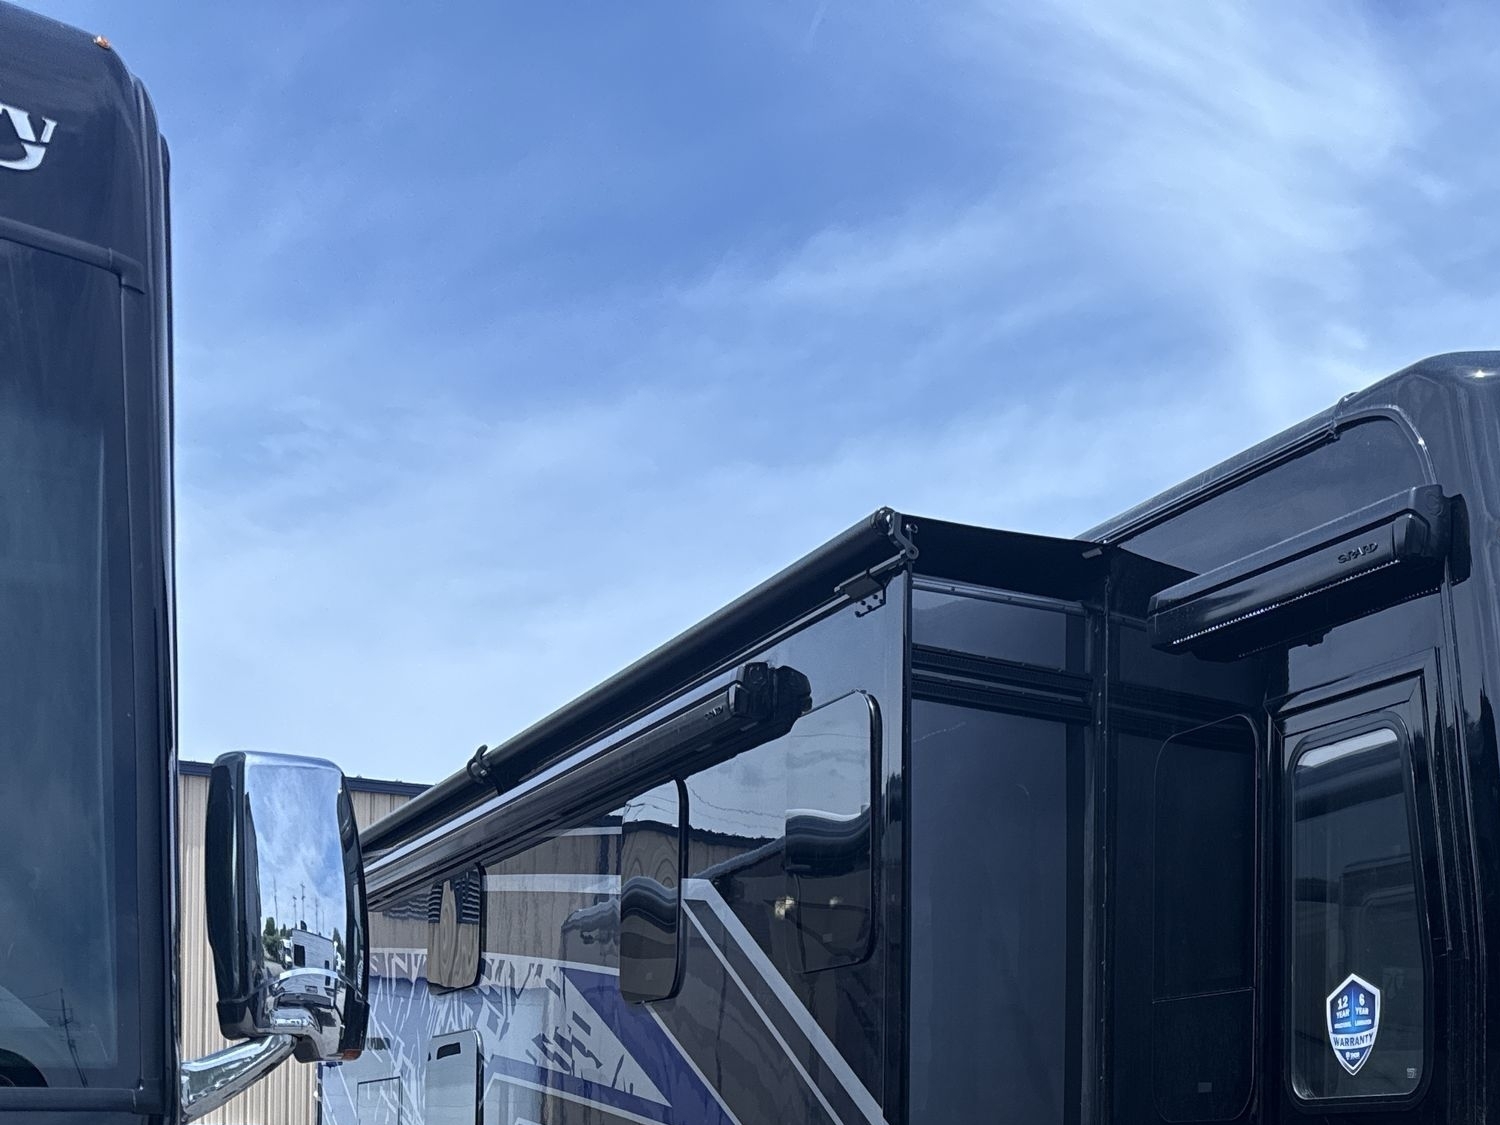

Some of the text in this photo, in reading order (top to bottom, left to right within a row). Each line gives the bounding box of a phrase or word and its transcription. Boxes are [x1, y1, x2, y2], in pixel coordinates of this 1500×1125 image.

[1337, 993, 1366, 1010] 12 6
[1336, 1007, 1369, 1019] YEAR YEAR
[1333, 1032, 1374, 1047] WARRANTY
